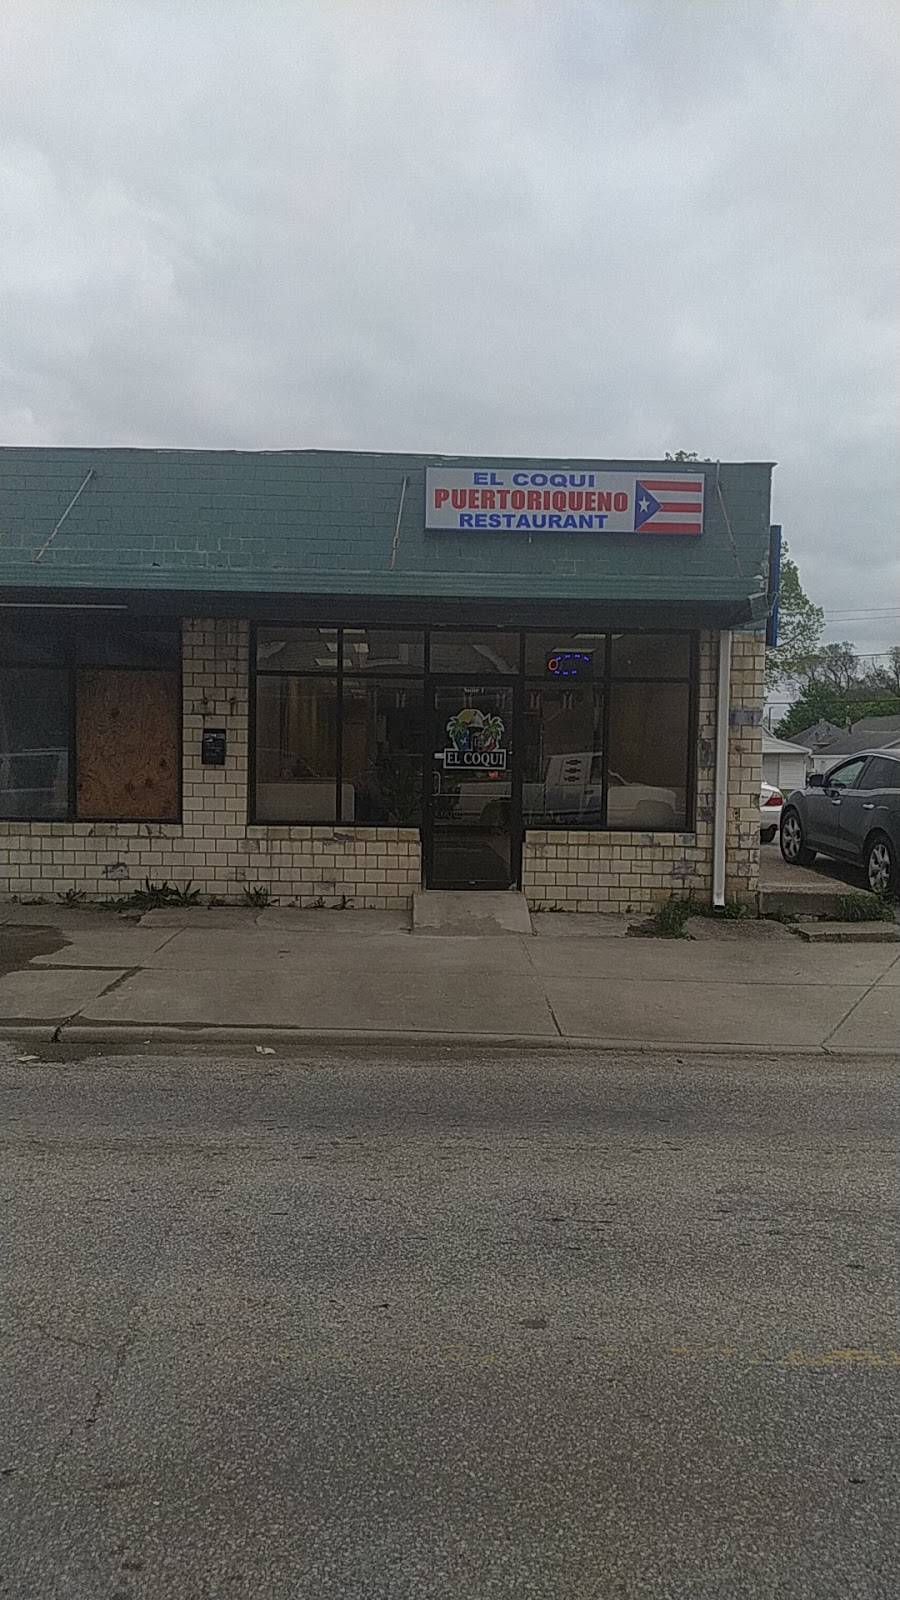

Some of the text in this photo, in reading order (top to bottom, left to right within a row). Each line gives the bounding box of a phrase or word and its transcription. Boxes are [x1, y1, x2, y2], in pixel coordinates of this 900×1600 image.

[473, 472, 595, 487] EL COQUI
[434, 489, 628, 512] PUERTORIQUENO
[459, 513, 608, 529] RESTAURANT
[447, 752, 503, 767] EL COQUI
